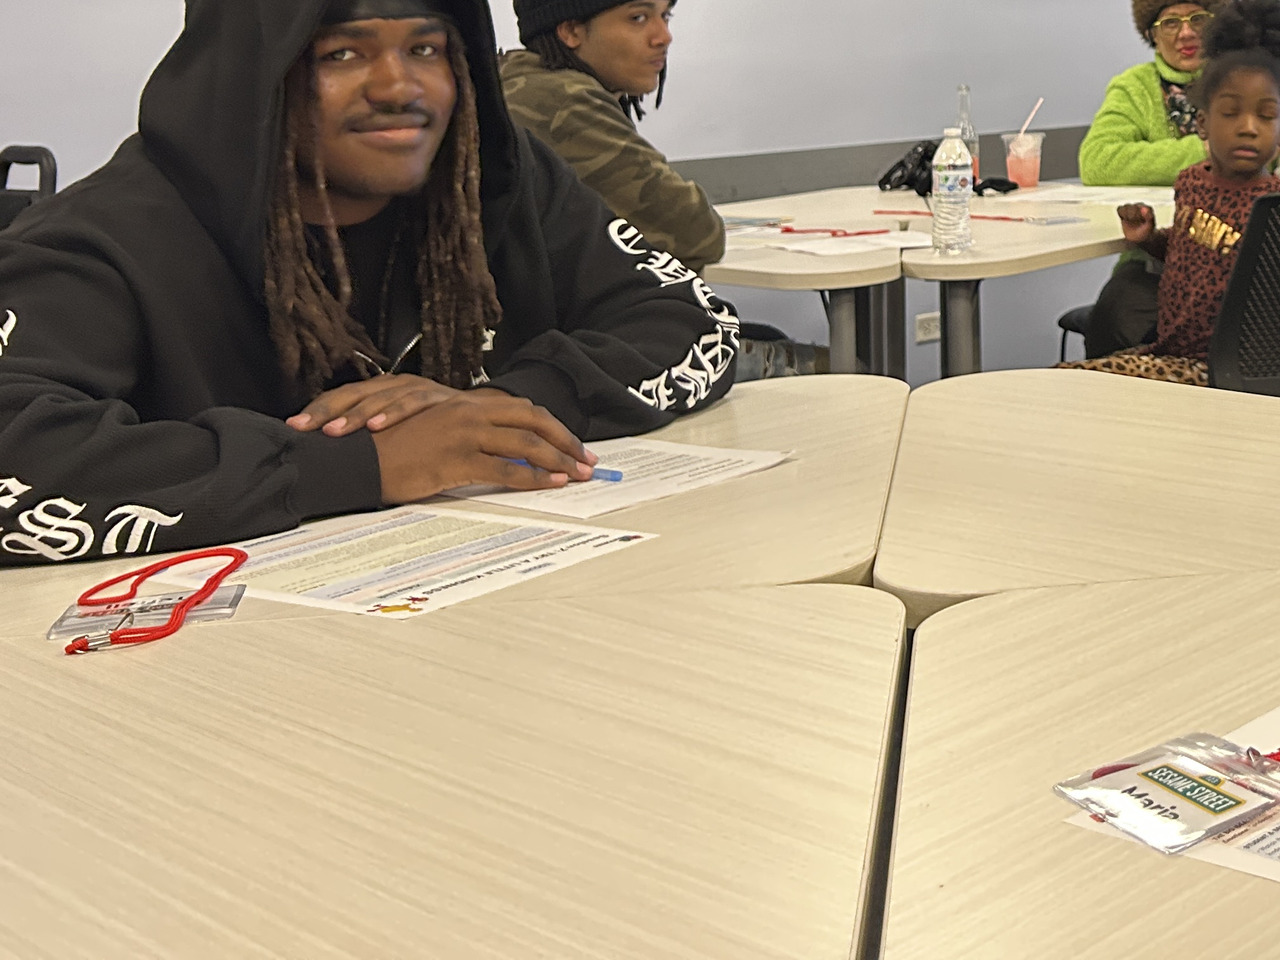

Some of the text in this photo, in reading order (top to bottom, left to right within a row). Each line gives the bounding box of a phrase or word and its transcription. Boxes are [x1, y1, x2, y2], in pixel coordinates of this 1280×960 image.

[1121, 785, 1180, 820] Maria
[1147, 768, 1236, 811] SESAME STREET
